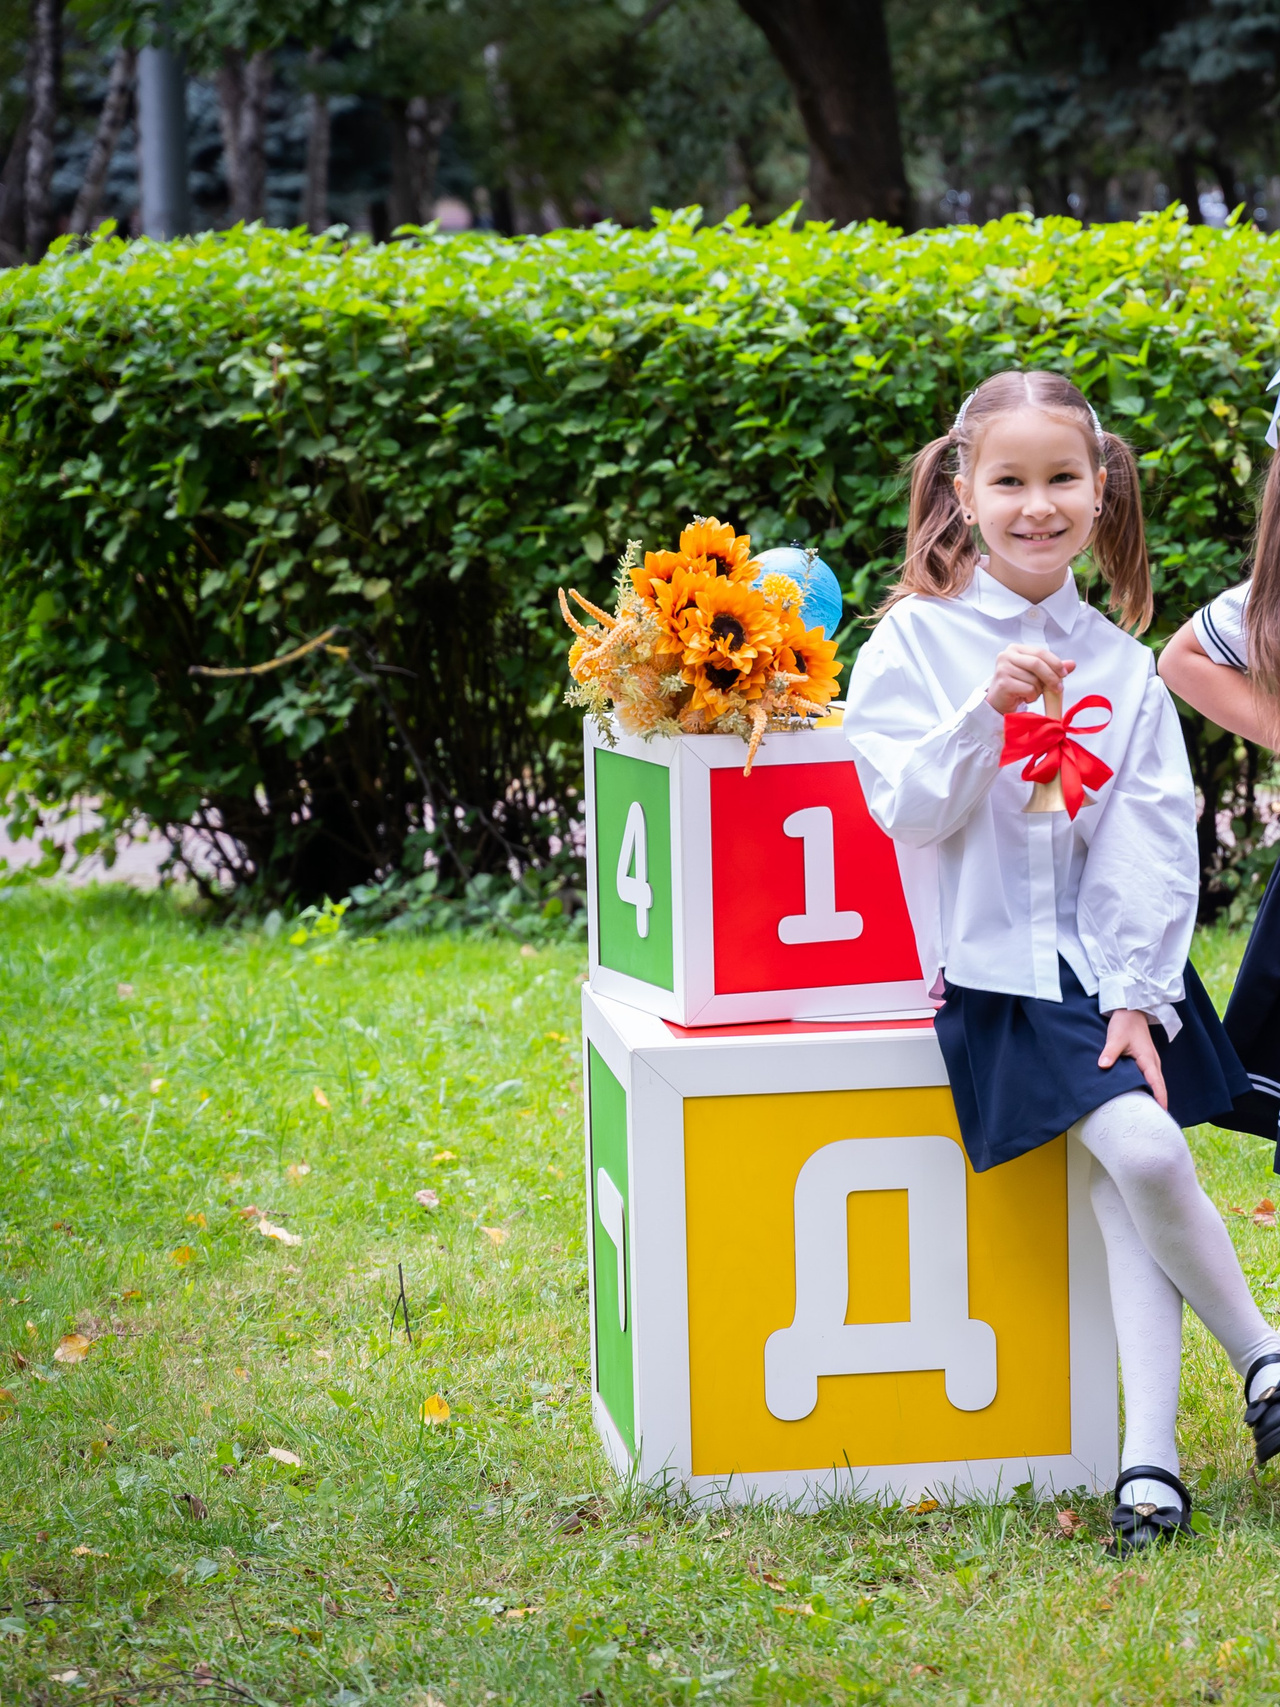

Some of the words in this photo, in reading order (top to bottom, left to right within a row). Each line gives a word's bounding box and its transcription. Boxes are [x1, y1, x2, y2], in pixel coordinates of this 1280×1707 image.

[616, 802, 653, 938] 4
[778, 806, 864, 945] 1
[764, 1136, 998, 1421] Д
